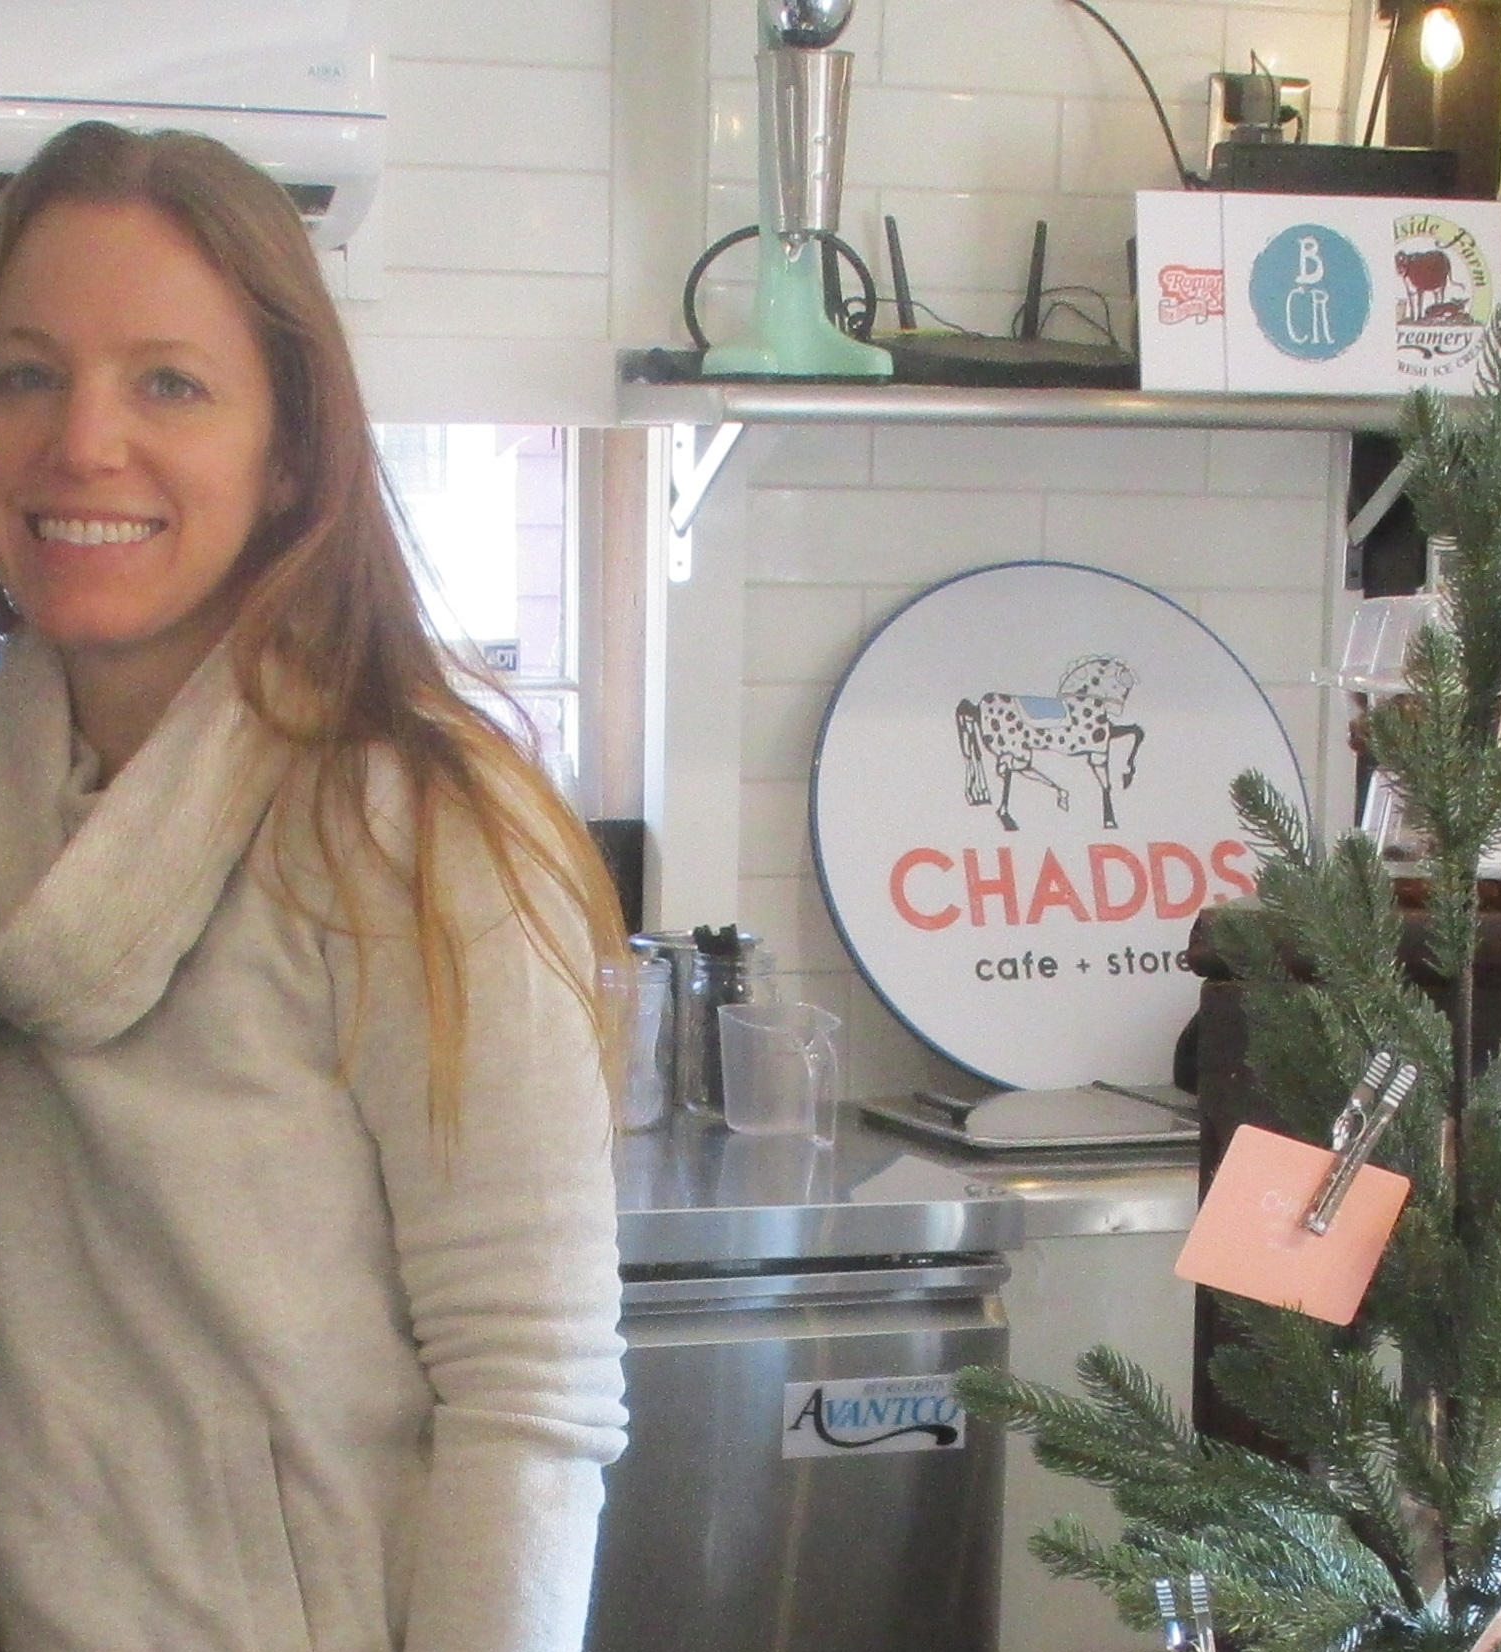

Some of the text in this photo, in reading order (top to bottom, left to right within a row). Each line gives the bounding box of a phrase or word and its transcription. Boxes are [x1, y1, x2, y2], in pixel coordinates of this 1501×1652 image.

[888, 839, 1258, 931] CHADDS
[975, 947, 1059, 982] cafe
[1107, 943, 1193, 977] store
